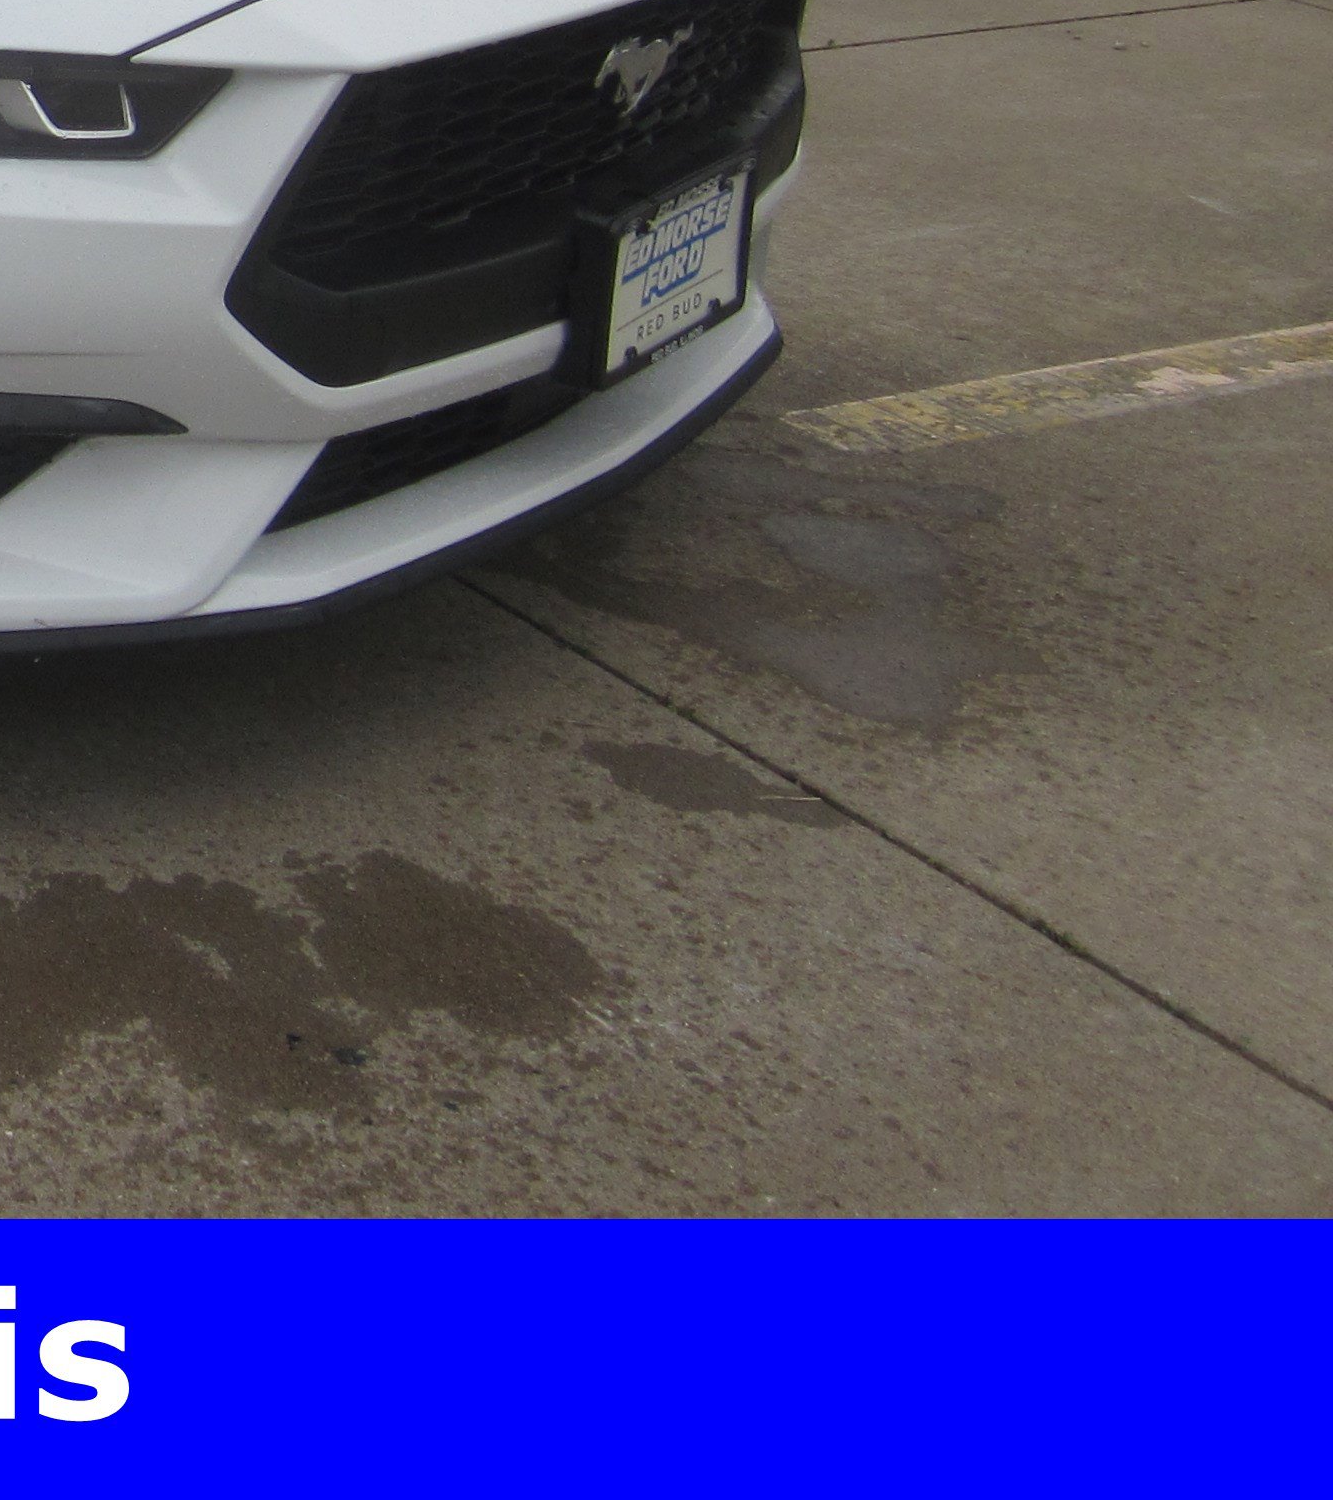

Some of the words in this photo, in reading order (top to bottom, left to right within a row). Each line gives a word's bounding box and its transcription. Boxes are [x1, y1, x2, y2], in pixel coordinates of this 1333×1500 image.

[622, 230, 657, 283] ED
[651, 191, 733, 260] MORSE
[641, 237, 706, 307] FORD
[636, 313, 665, 341] RED
[672, 292, 703, 321] BUD
